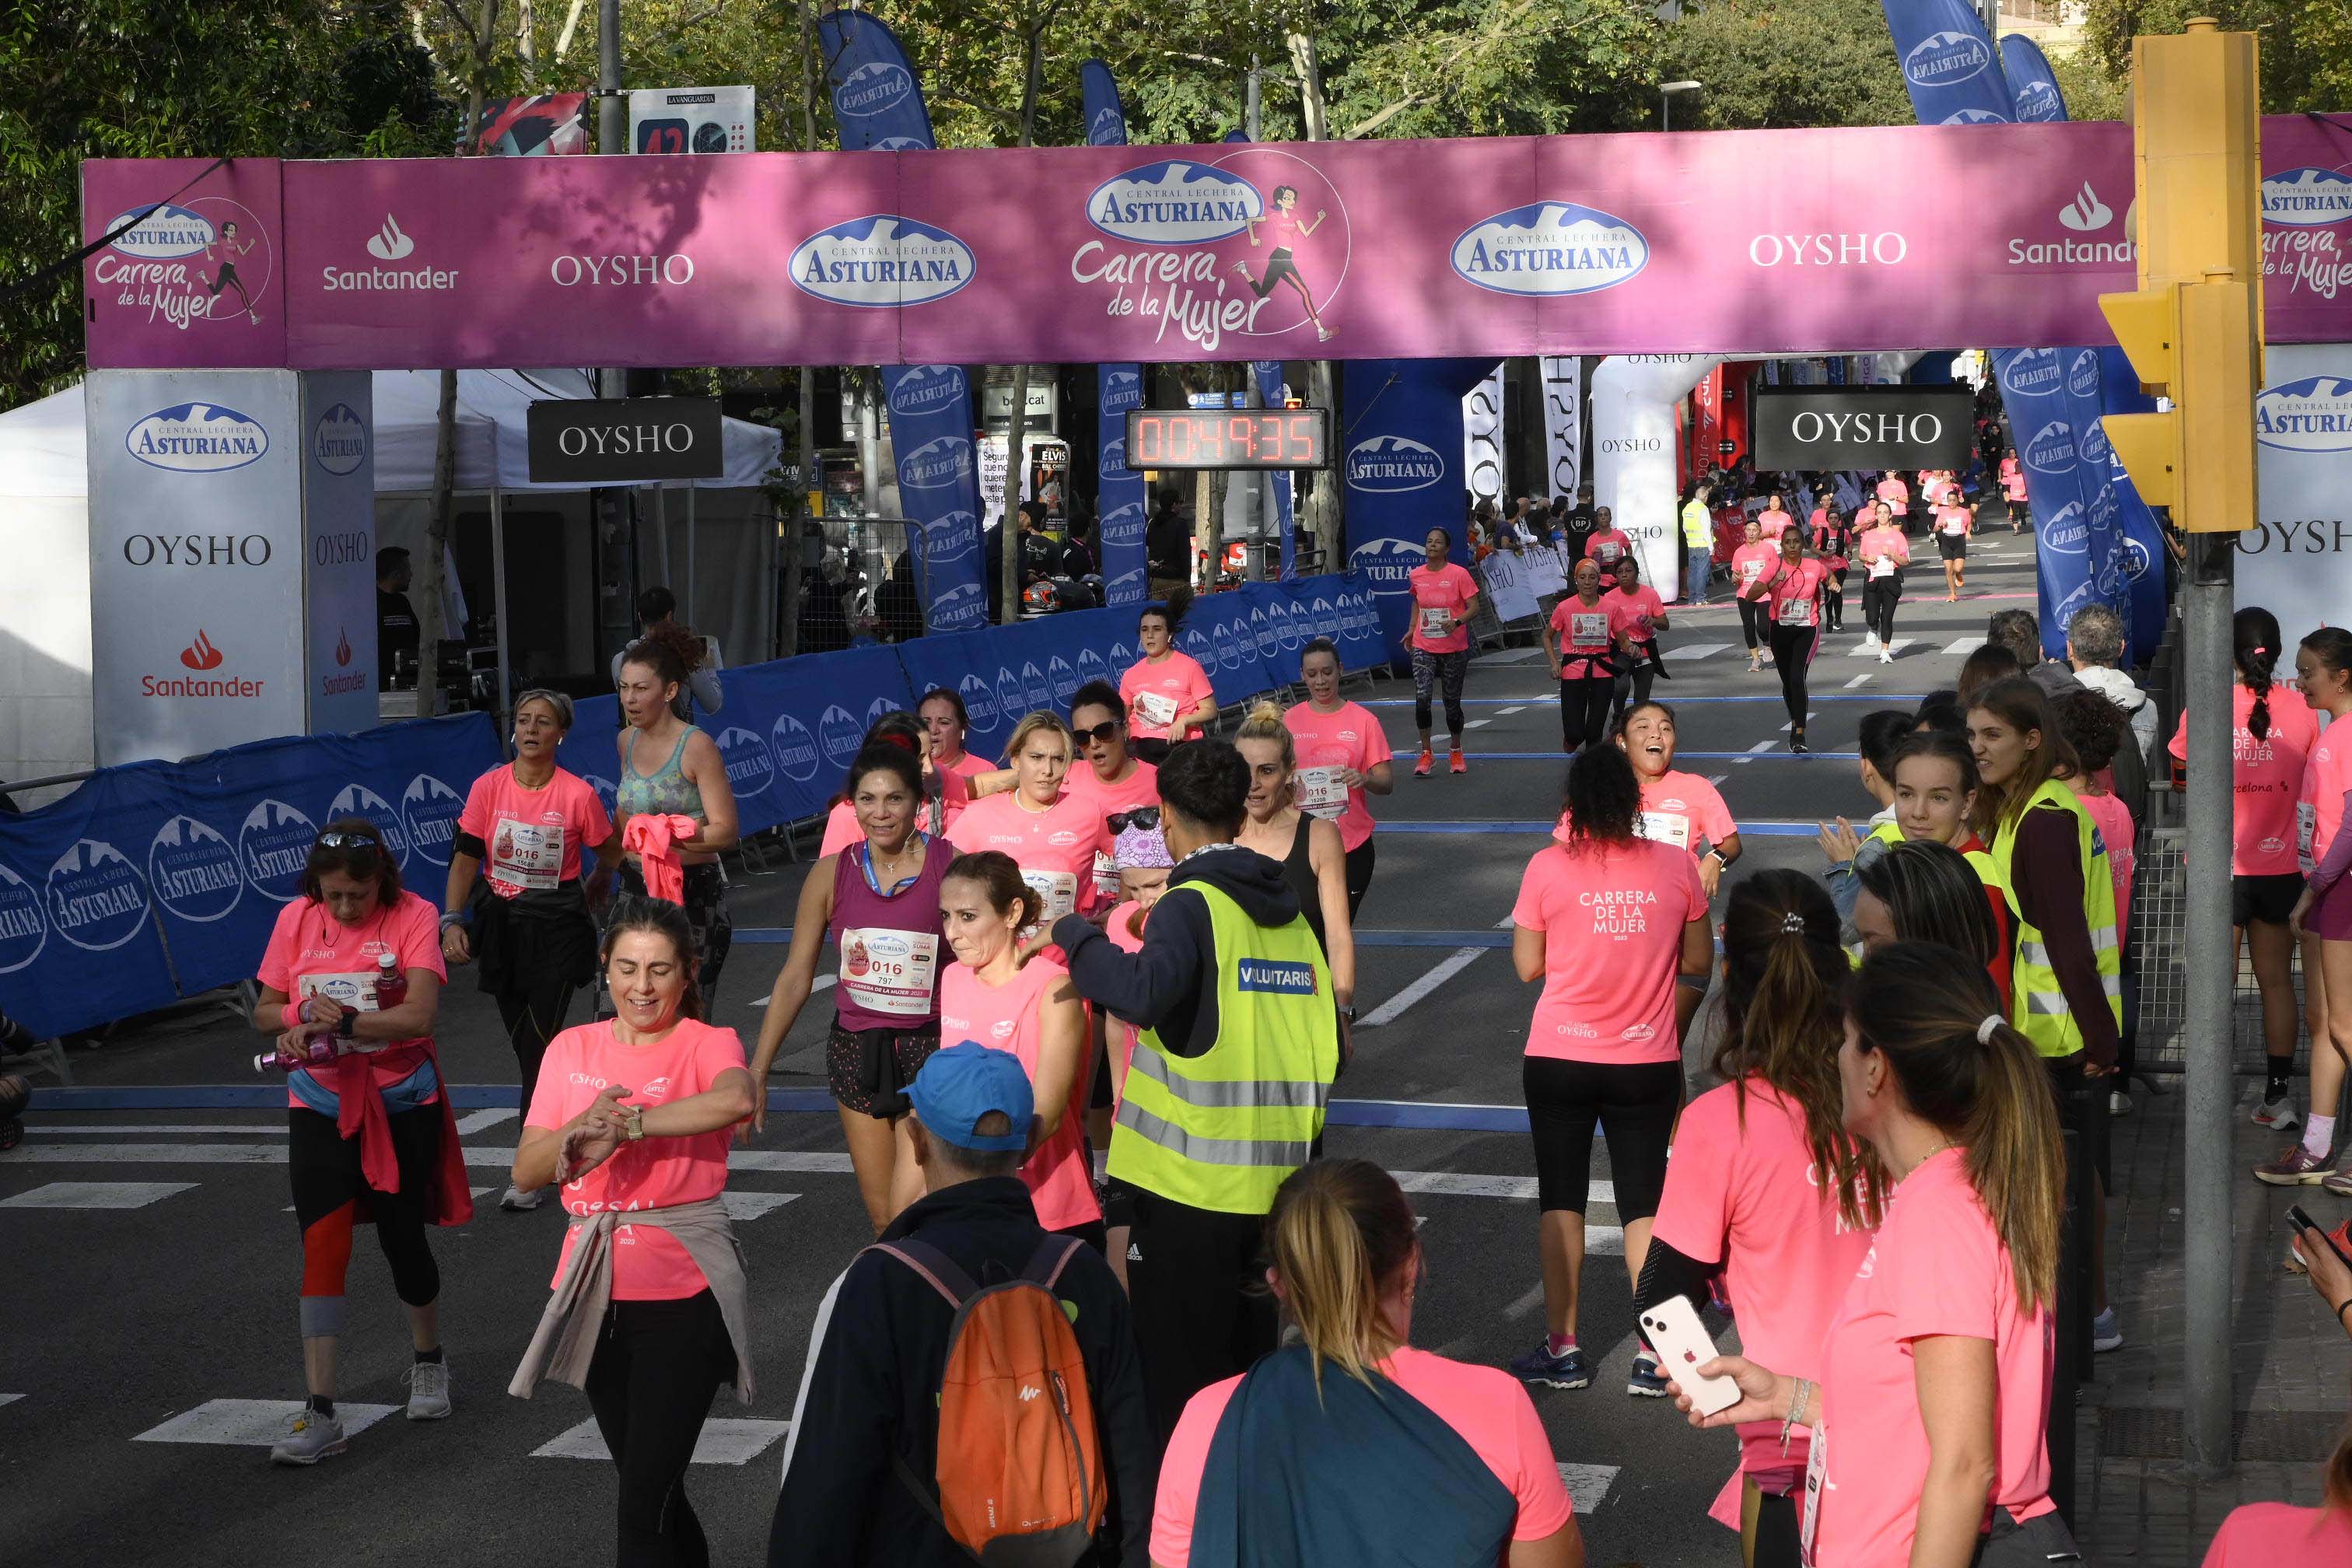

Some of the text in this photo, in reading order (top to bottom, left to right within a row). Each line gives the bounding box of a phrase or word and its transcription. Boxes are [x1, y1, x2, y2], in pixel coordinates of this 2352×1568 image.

[1127, 187, 1244, 198] CENTRAL LECHERA
[1101, 192, 1248, 224] ASTURIANA
[113, 224, 207, 244] ASTURIANA
[1497, 233, 1627, 245] CENTRAL LECHERA
[2262, 230, 2335, 254] arrera
[832, 246, 955, 257] CENTRAL LECHERA
[1071, 240, 1217, 284] Carrera
[1466, 237, 1633, 273] ASTURIANA
[1750, 233, 1908, 267] OYSHO
[2008, 238, 2139, 264] Santand
[95, 255, 187, 284] Carrera
[323, 265, 459, 291] Santander
[551, 254, 695, 285] OYSHO
[802, 249, 961, 284] ASTURIANA
[2280, 254, 2294, 275] la
[2291, 249, 2352, 299] Muje
[118, 281, 222, 330] de la Mujer
[1107, 279, 1271, 352] de la Mujer
[2278, 402, 2330, 411] CENTRAL
[159, 425, 254, 435] CENTRAL LECHERA
[1792, 412, 1942, 444] OYSHO
[2257, 405, 2352, 433] ASTURI
[137, 429, 258, 455] ASTURIANA
[318, 430, 363, 457] ASTURIANA
[559, 424, 694, 456] OYSHO
[1139, 417, 1313, 461] 00:49:35
[1602, 438, 1661, 453] OYSHO
[1042, 451, 1066, 461] ELVIS
[1349, 458, 1437, 479] ASTURIANA
[317, 531, 367, 566] OYSHO
[2236, 520, 2352, 555] OYSH
[124, 534, 271, 566] OYSHO
[142, 675, 264, 698] Santander
[323, 671, 366, 697] Santander
[2233, 750, 2273, 761] MUJER
[2234, 739, 2271, 750] DE LA
[726, 754, 772, 782] STURIANA
[1308, 787, 1327, 796] 016
[410, 811, 454, 847] ASTURI
[167, 849, 195, 865] CENTRAL
[516, 848, 539, 859] 016
[517, 859, 535, 868] 15686
[159, 859, 240, 901] ASTURIANA
[1580, 891, 1657, 906] CARRERA
[1595, 905, 1643, 919] DE LA
[1594, 919, 1646, 934] MUJER
[871, 942, 906, 953] ASTURIANA
[872, 961, 902, 975] 016
[326, 987, 355, 996] ASTURIANA
[850, 982, 874, 991] CARRERA
[878, 977, 892, 985] 797
[1557, 1025, 1598, 1039] OYSHO
